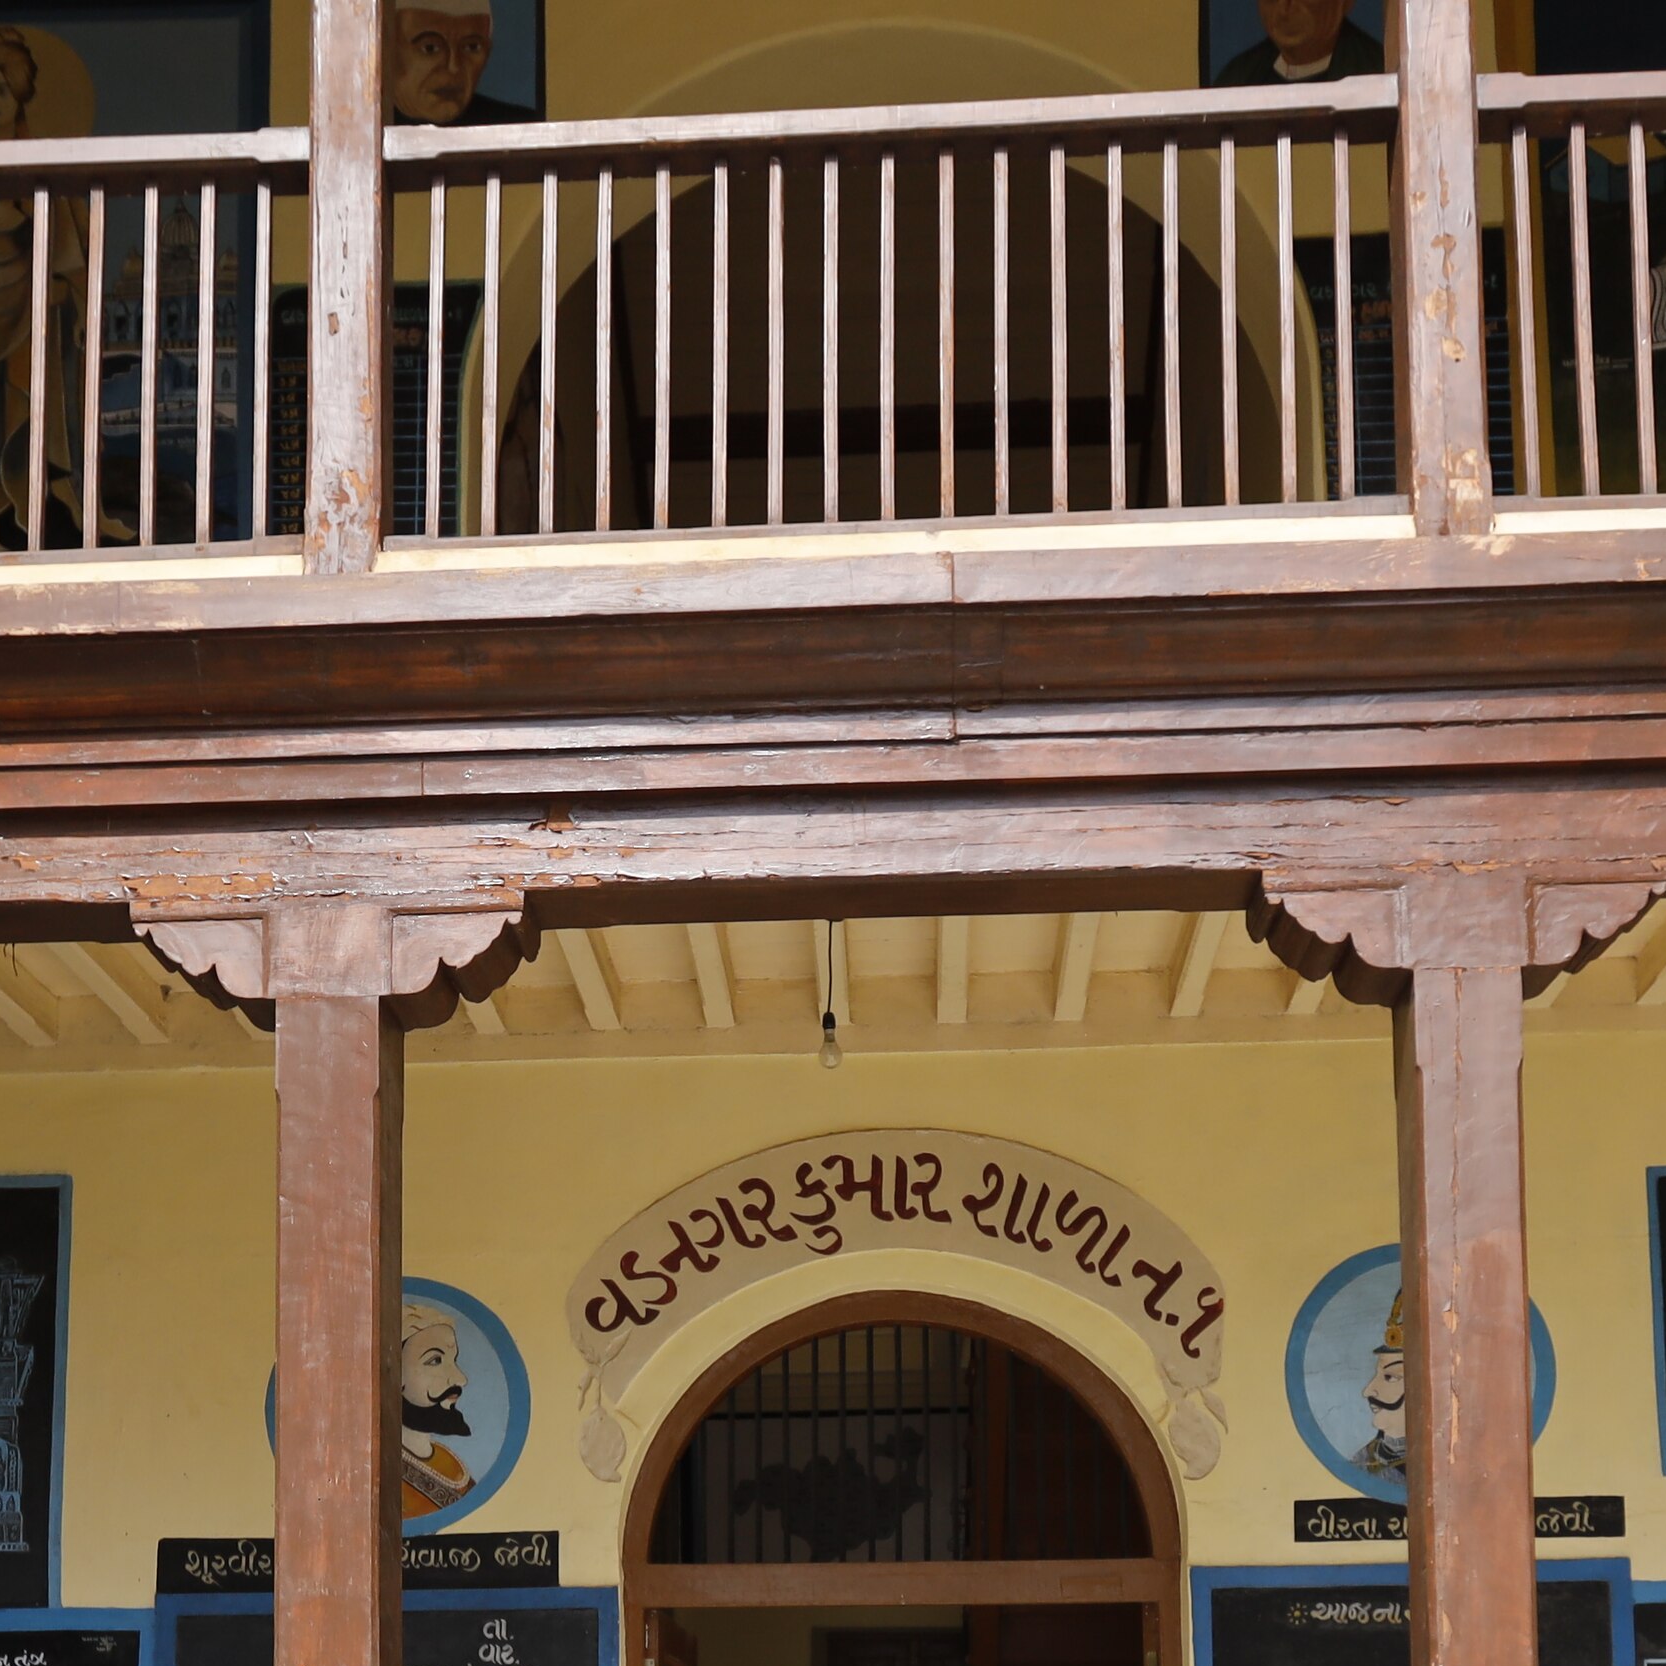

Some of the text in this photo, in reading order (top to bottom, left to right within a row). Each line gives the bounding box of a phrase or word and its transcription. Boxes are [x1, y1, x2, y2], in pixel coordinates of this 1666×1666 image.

[584, 1176, 793, 1334] વડનગર
[790, 1151, 951, 1255] કુમાર
[962, 1162, 1131, 1288] શાળા
[1307, 1504, 1383, 1540] વીરતા
[1536, 1501, 1596, 1535] જેવી
[493, 1533, 552, 1568] જેવી
